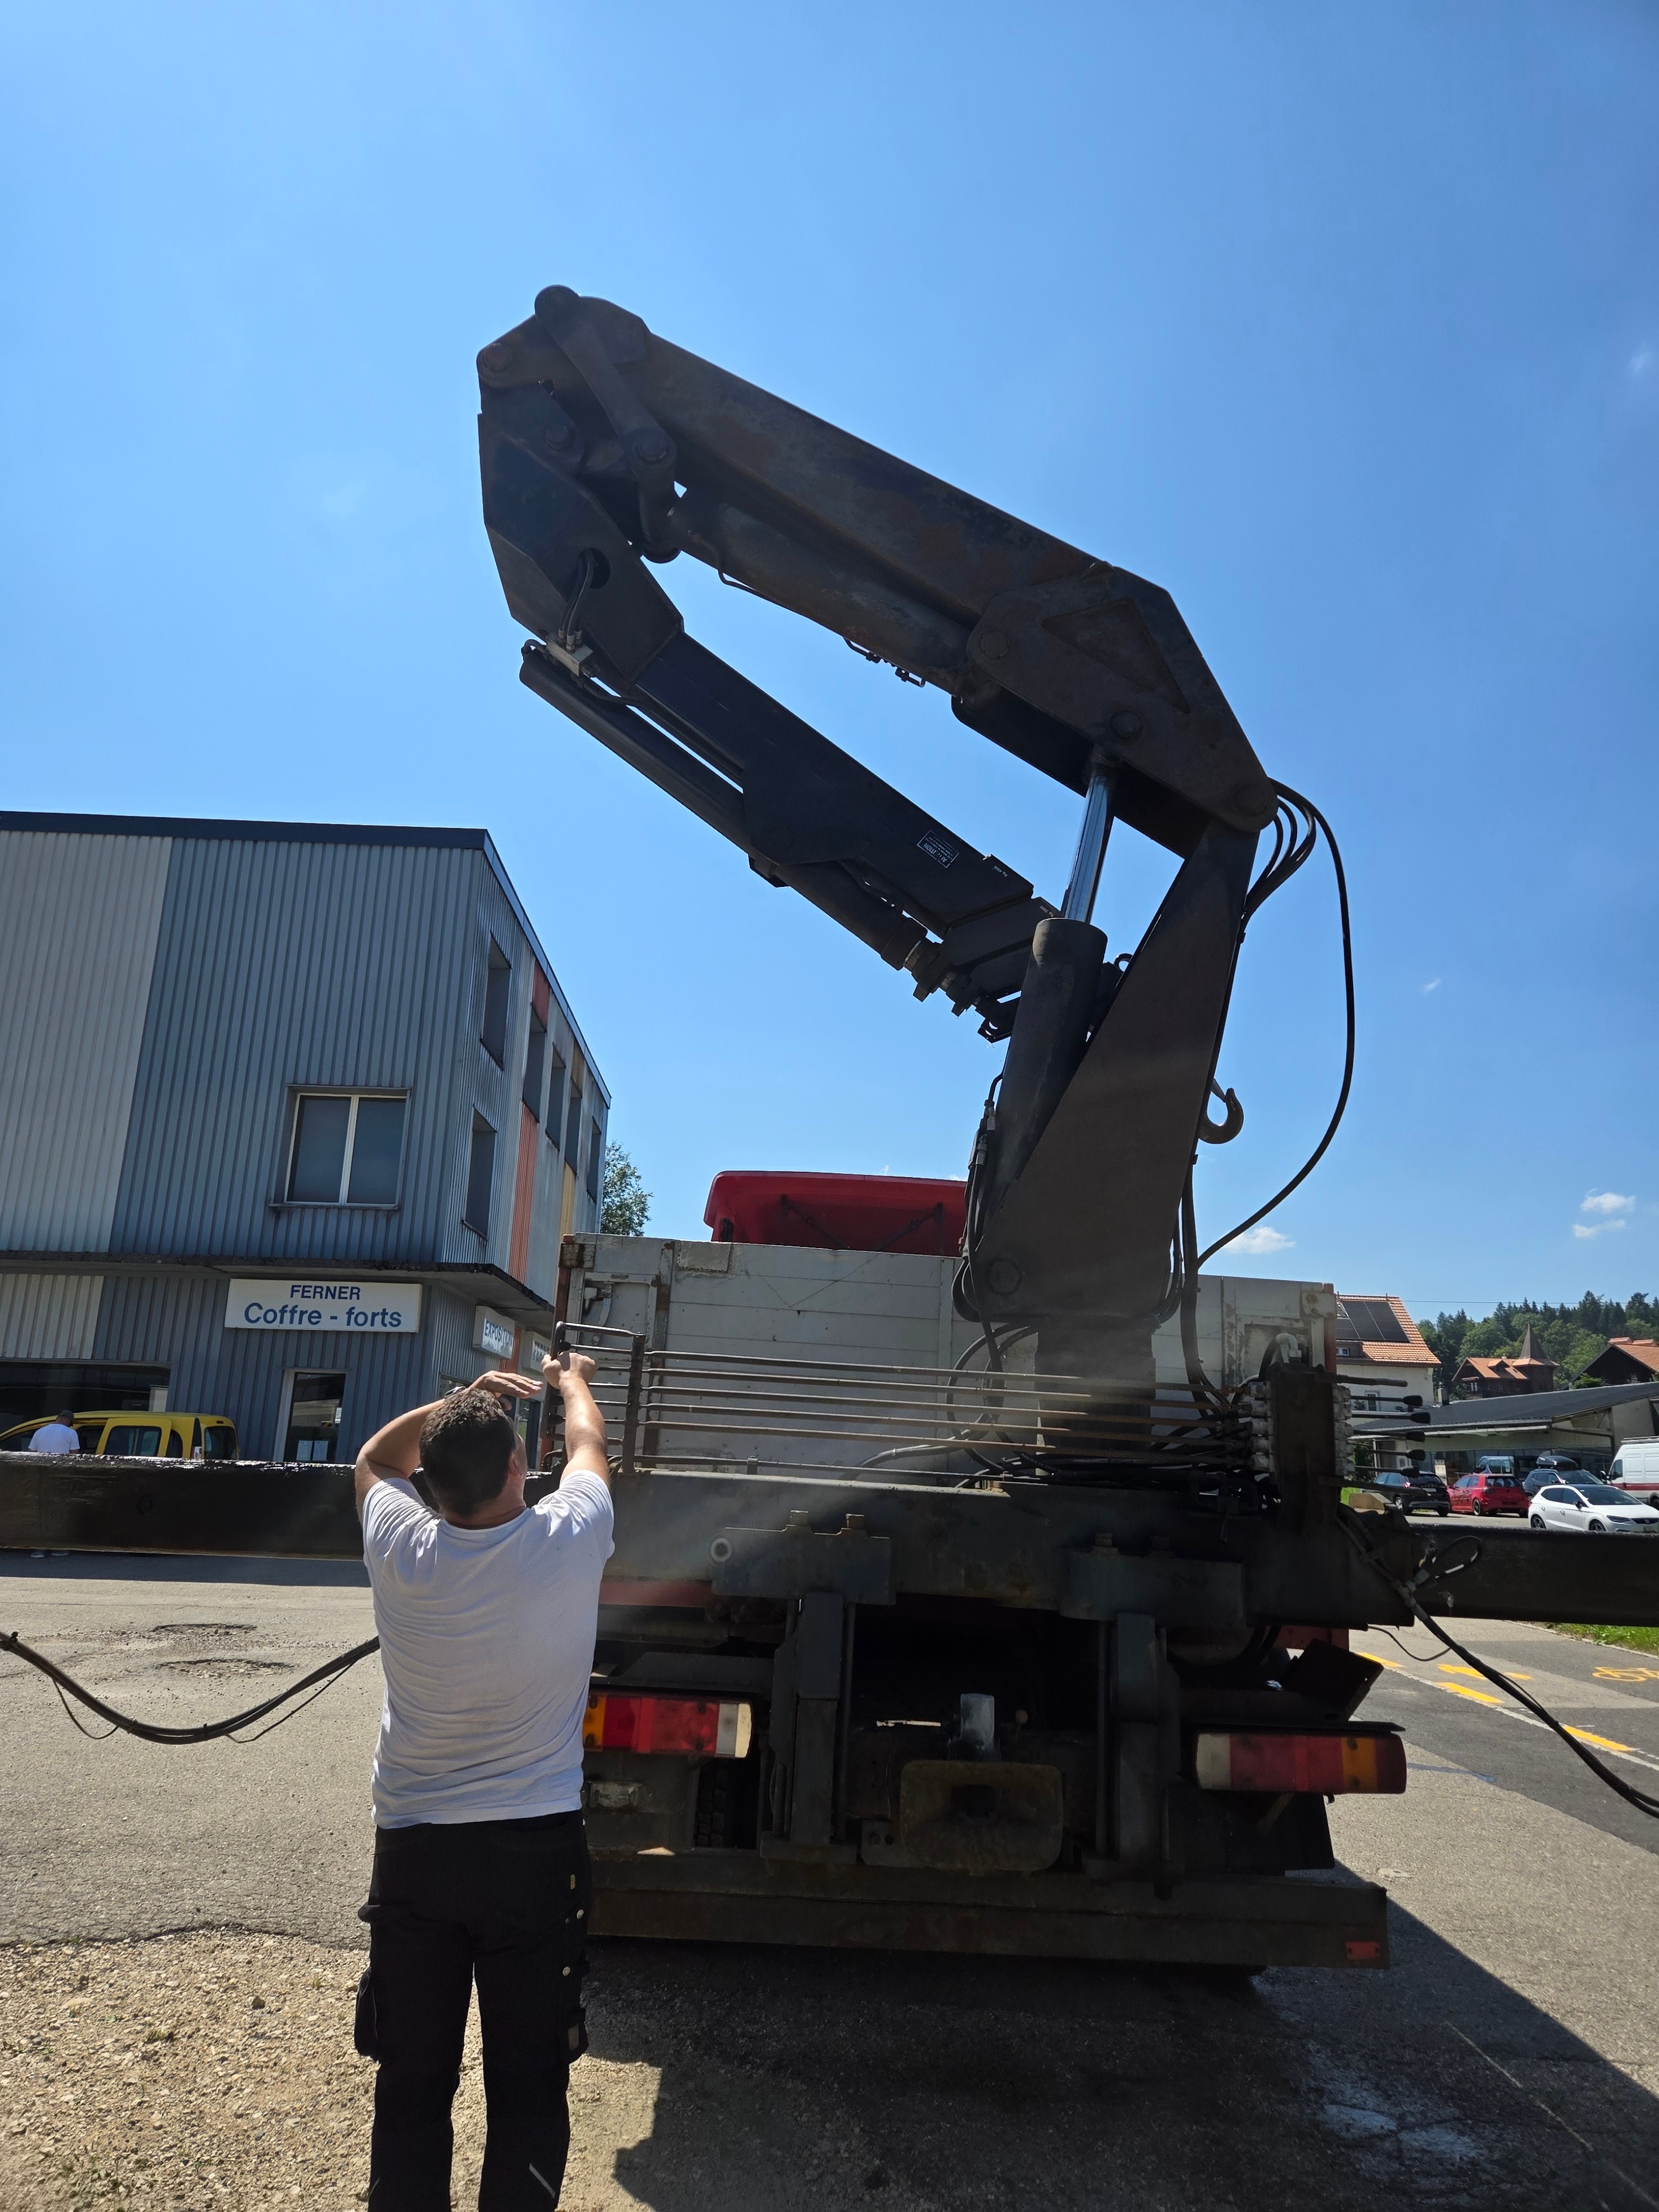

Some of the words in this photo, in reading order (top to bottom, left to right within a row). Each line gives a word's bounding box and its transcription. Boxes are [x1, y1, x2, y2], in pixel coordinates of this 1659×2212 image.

[290, 1285, 361, 1300] FERNER
[244, 1302, 322, 1326] Coffre
[346, 1306, 402, 1328] forts
